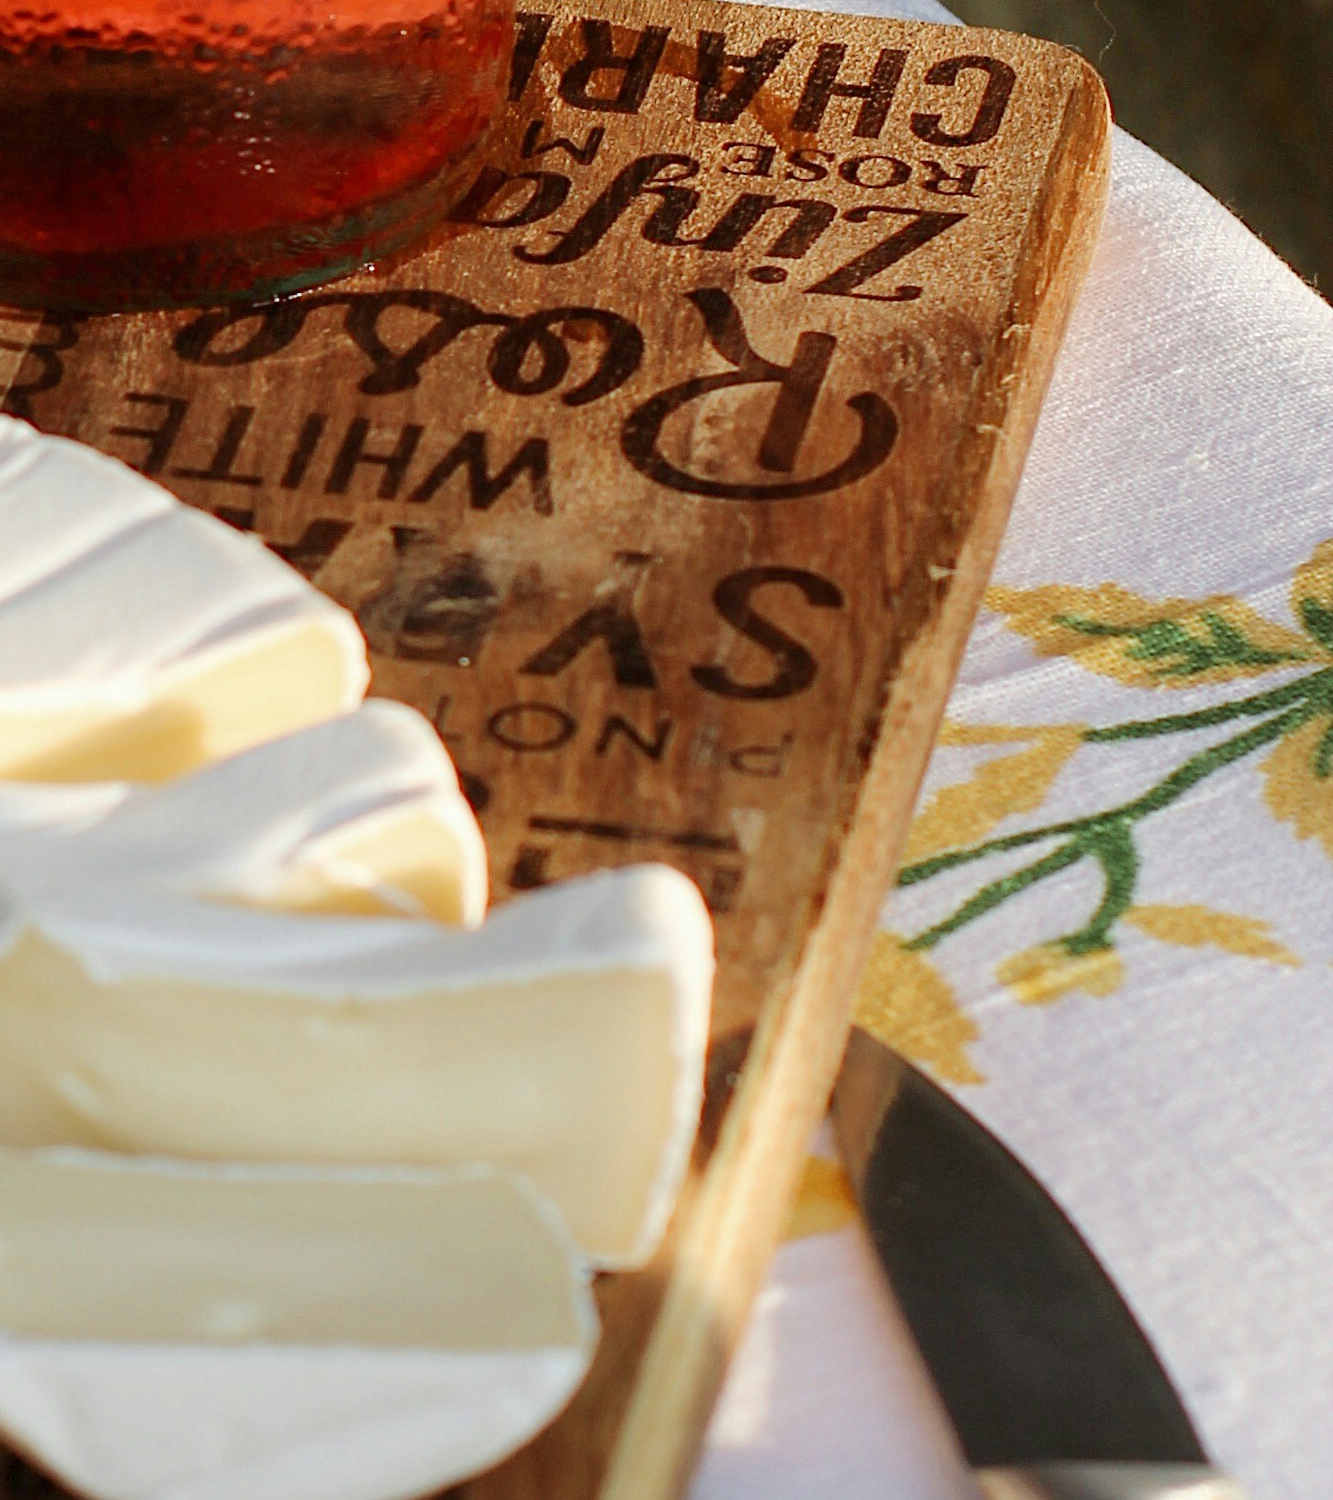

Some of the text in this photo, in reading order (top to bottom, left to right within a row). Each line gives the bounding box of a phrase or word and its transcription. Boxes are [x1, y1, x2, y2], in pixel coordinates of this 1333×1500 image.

[445, 153, 970, 304] Zinfa
[719, 141, 985, 200] ROSE
[107, 392, 556, 519] WHITE
